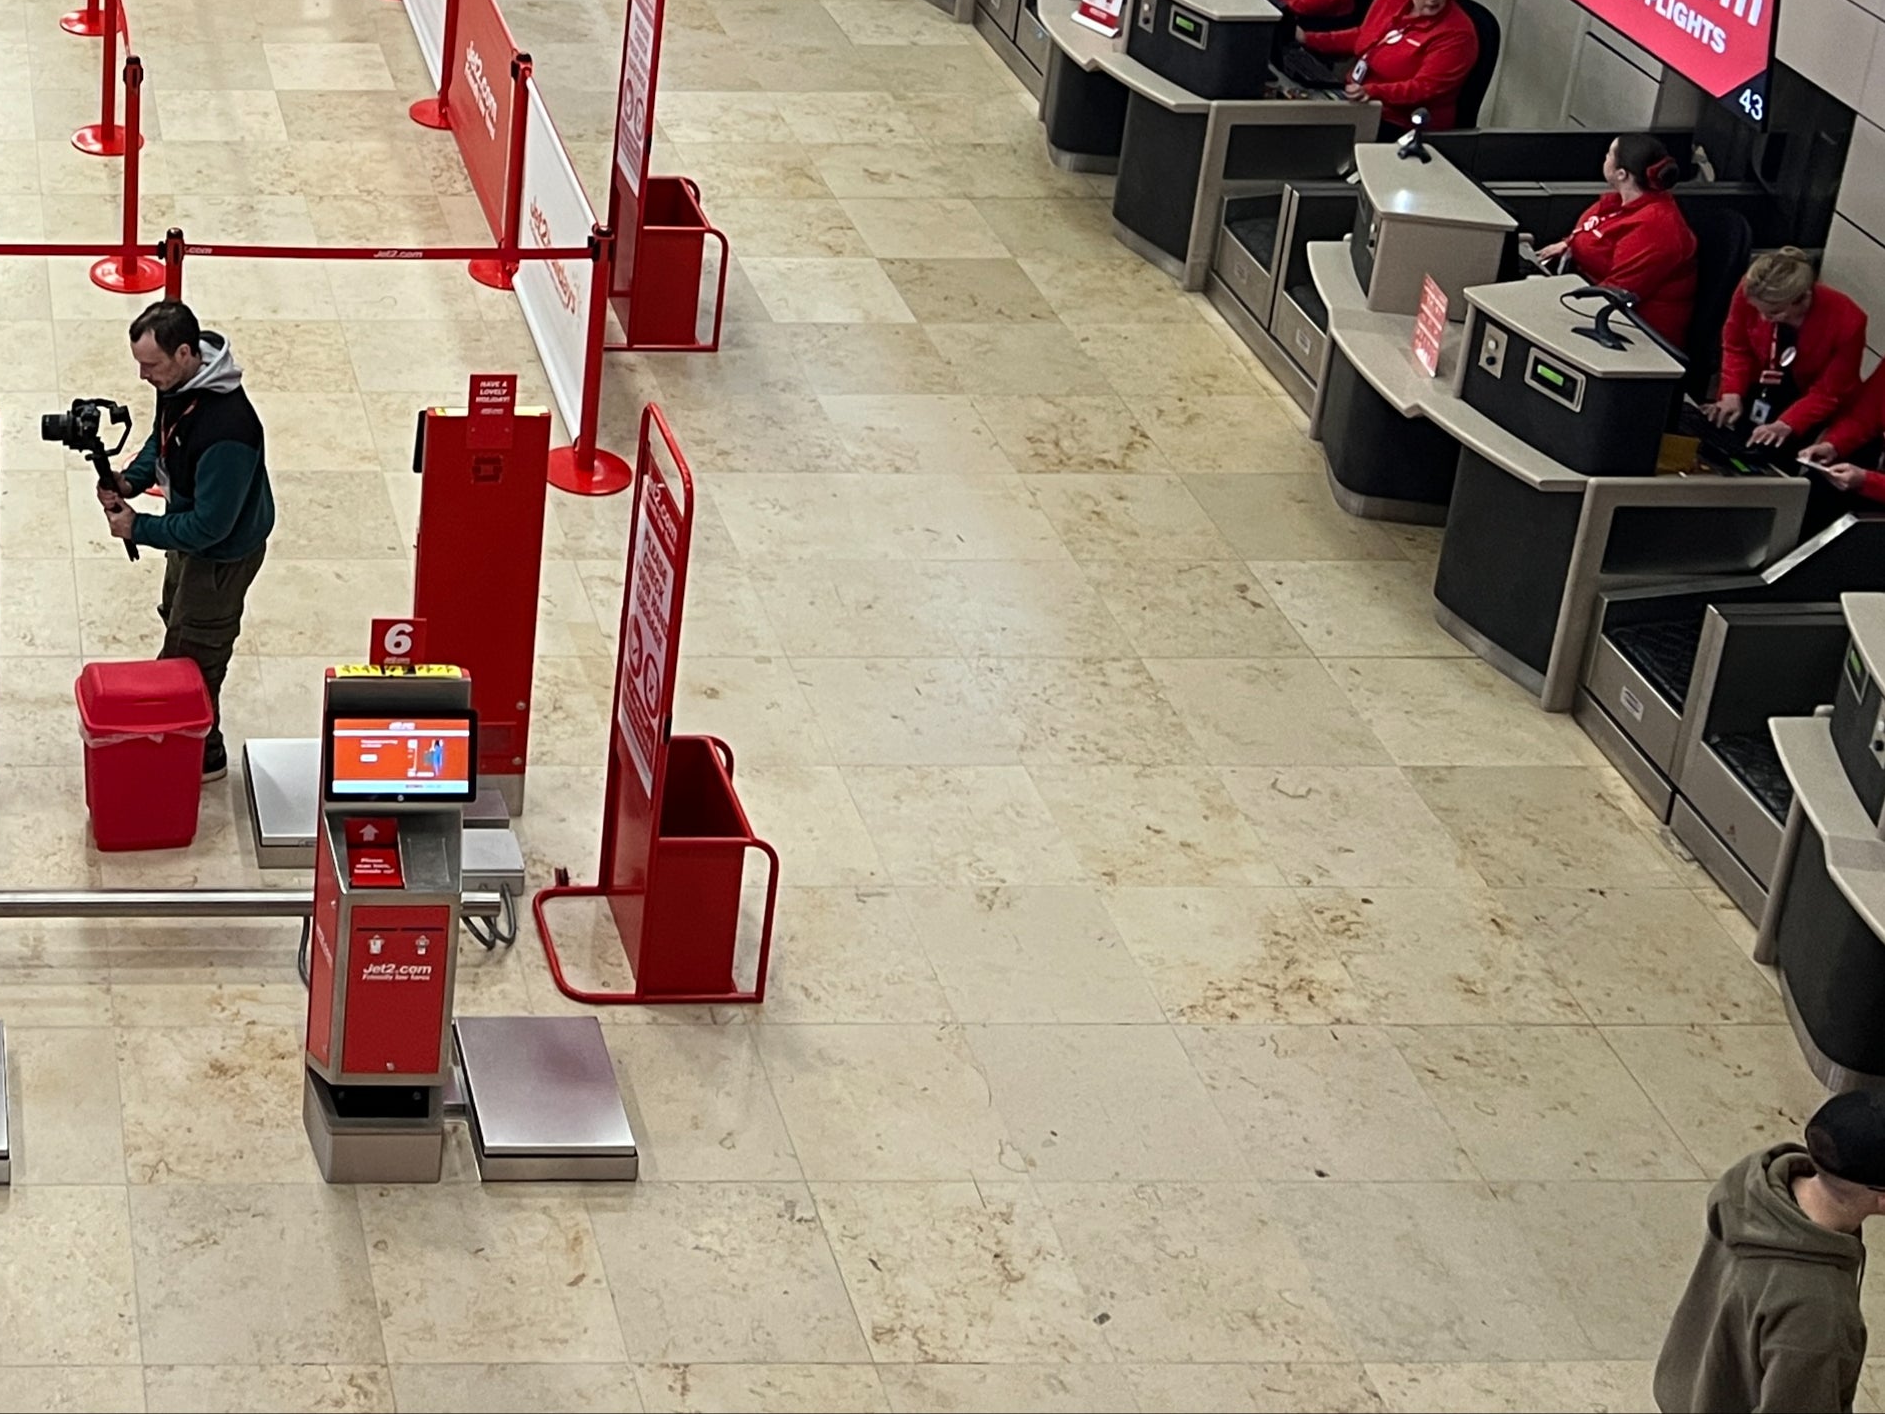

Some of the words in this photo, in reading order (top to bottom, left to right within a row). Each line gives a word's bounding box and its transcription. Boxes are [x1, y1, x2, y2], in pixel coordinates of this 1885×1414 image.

[1738, 87, 1764, 122] 43
[373, 250, 423, 259] Jet2.com
[383, 622, 414, 655] 6
[362, 962, 432, 975] Jet2.com
